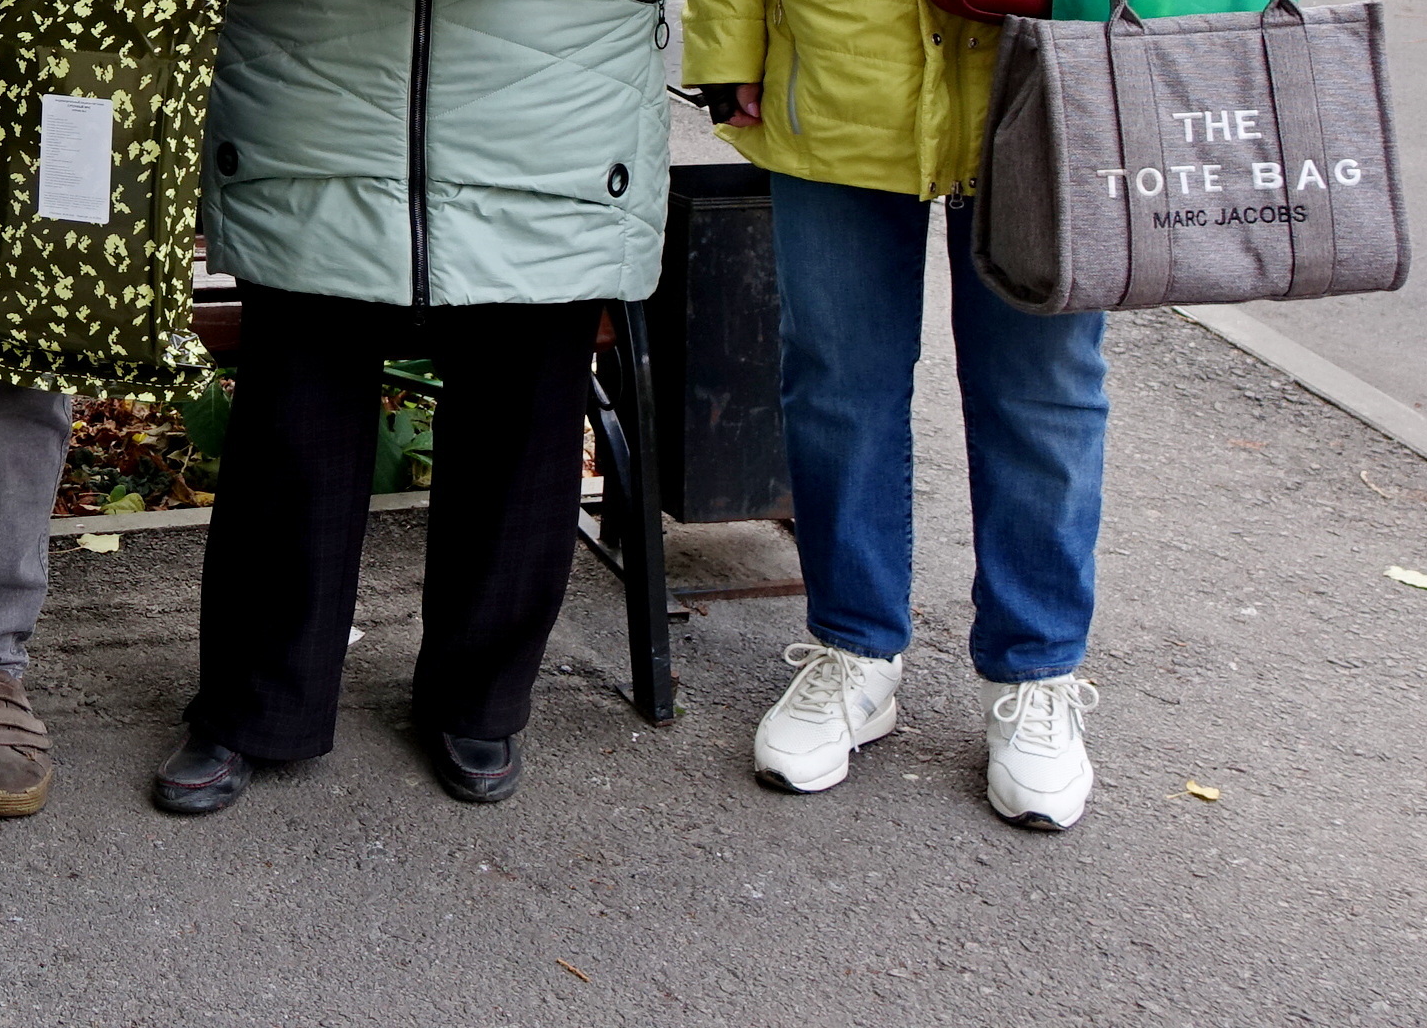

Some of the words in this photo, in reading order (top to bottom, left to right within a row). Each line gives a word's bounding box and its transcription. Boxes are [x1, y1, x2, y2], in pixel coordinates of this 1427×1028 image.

[1172, 109, 1262, 143] THE
[1096, 164, 1223, 198] TOTE
[1251, 158, 1362, 191] BAG
[1153, 209, 1208, 229] MARC
[1214, 205, 1308, 226] JACOBS
